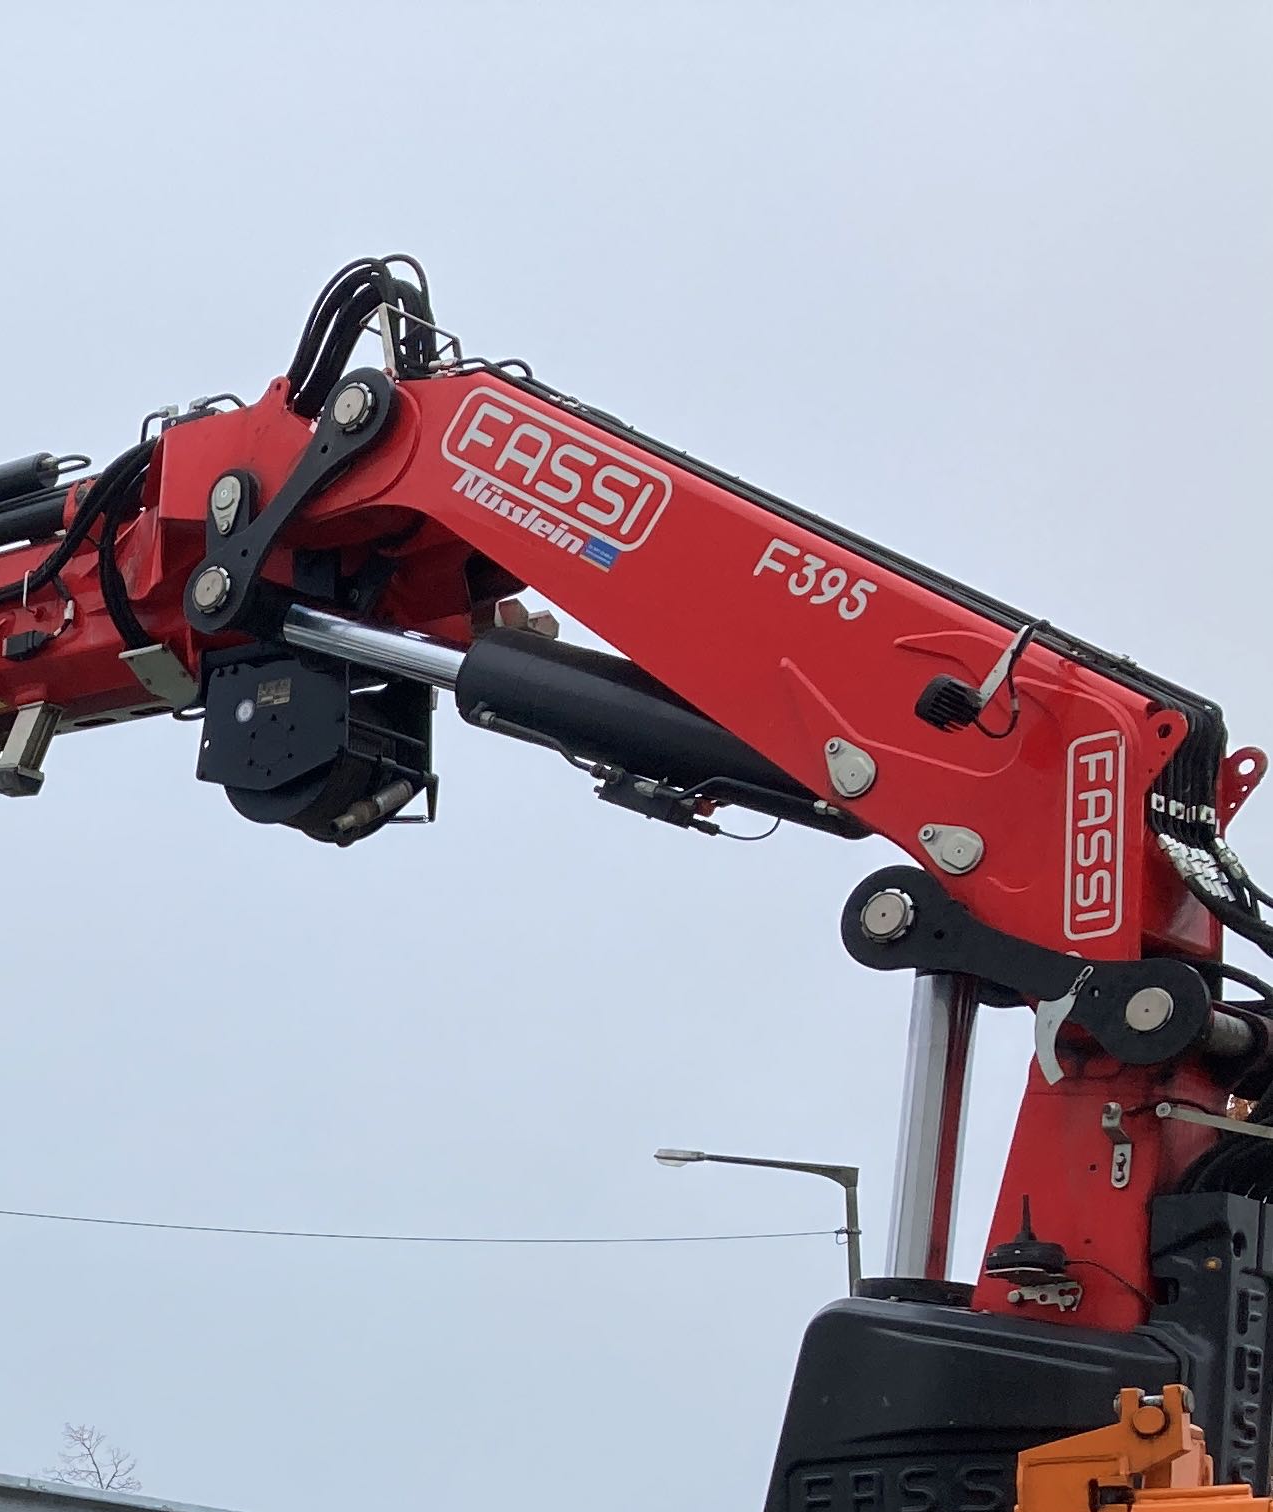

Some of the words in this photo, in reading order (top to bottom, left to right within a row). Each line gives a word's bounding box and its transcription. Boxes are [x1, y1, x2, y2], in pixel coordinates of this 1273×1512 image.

[451, 470, 585, 555] Nüsslein
[457, 402, 655, 536] FASSI
[752, 537, 878, 620] F395
[1074, 749, 1114, 922] FASSI
[1232, 1287, 1266, 1487] FASS
